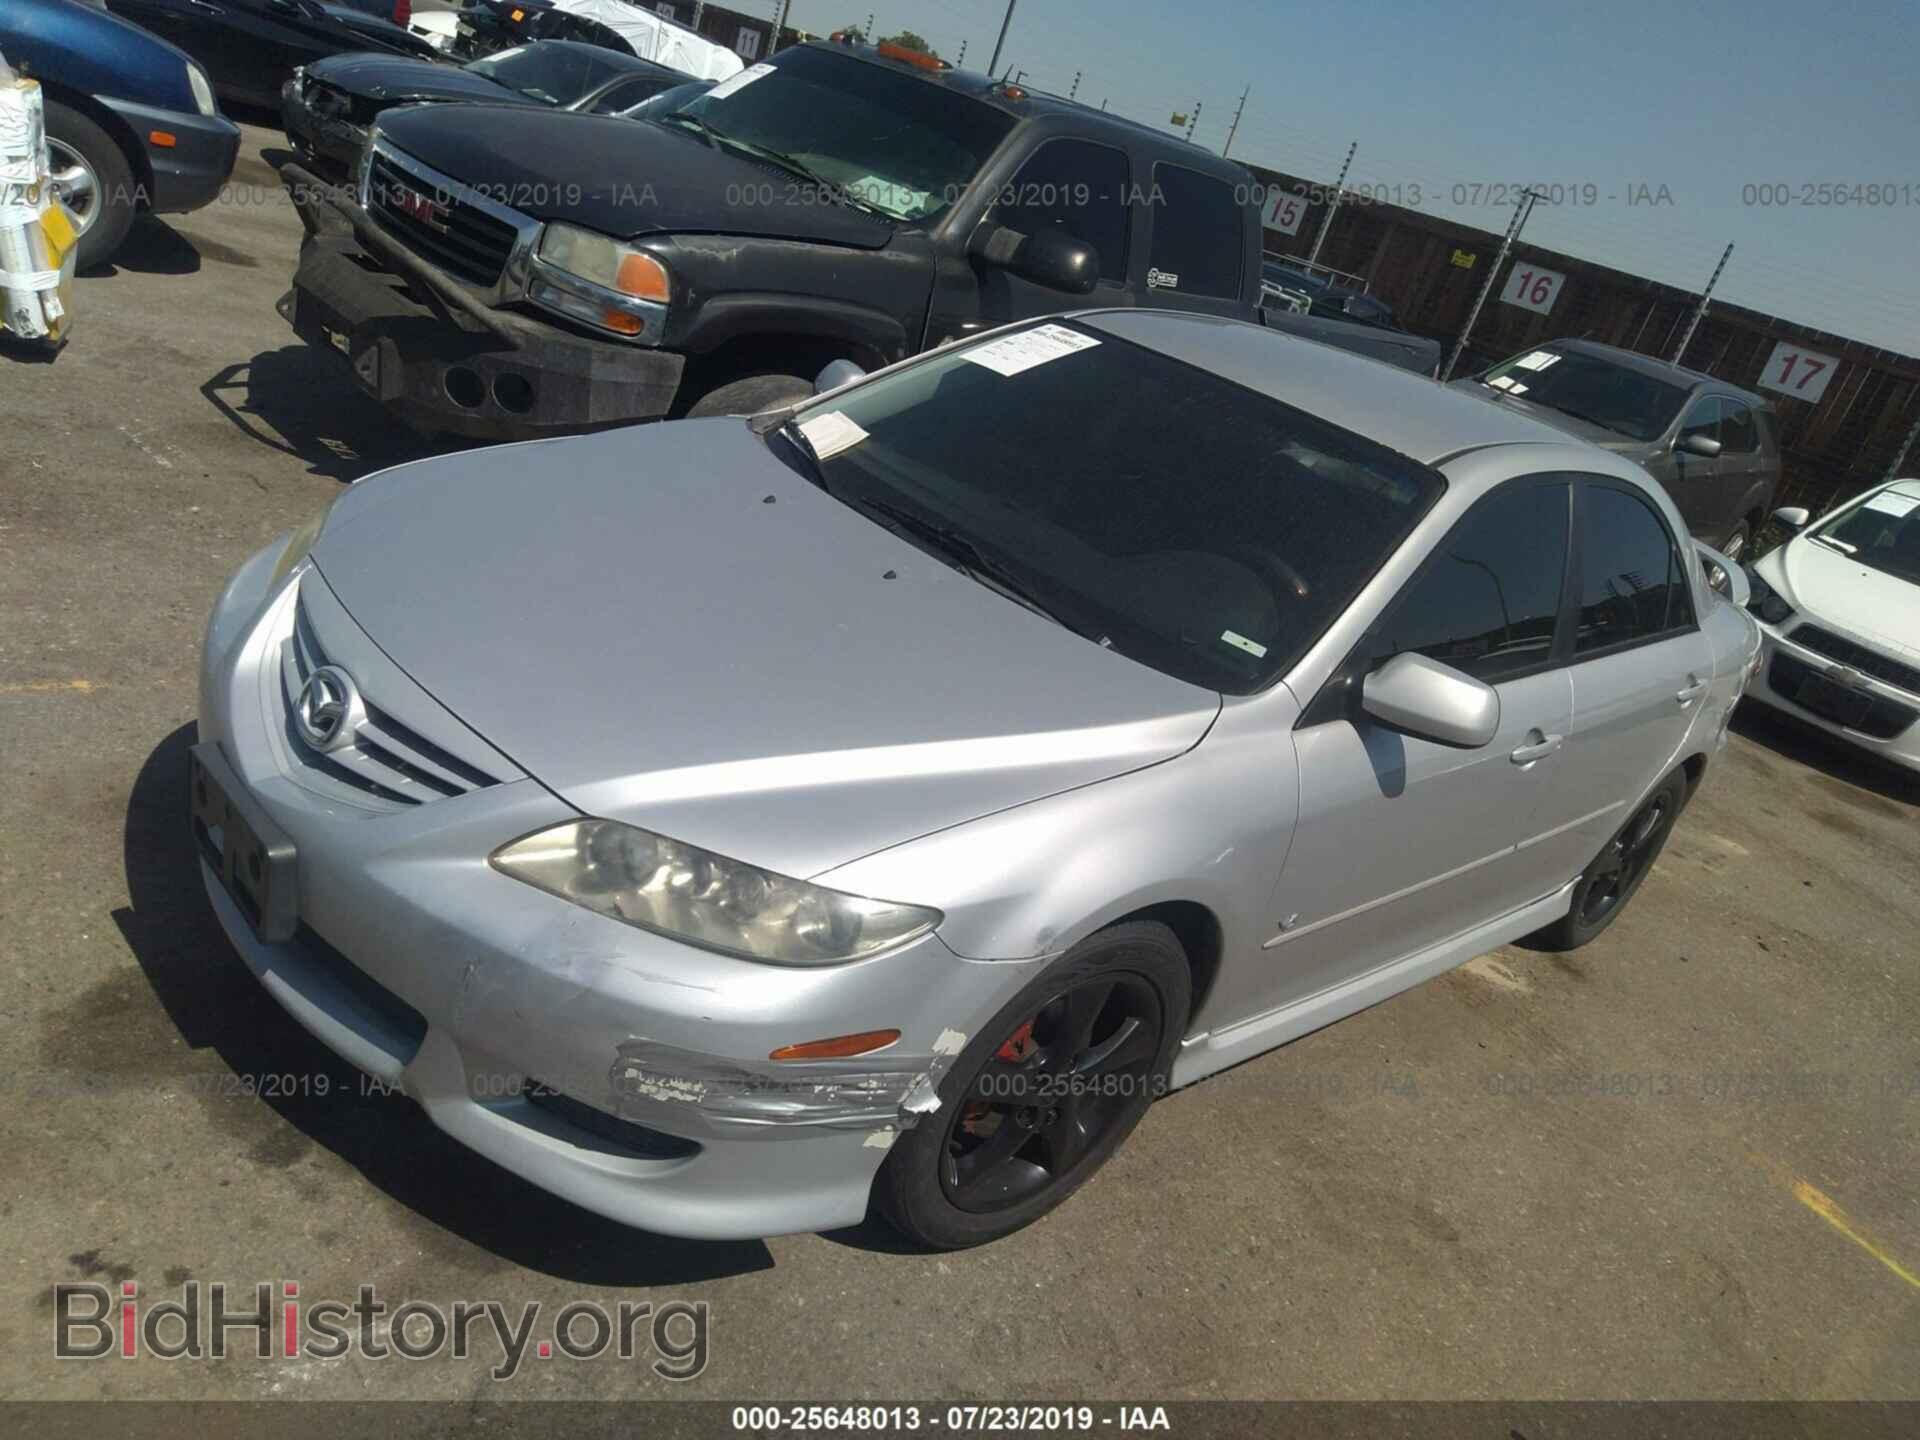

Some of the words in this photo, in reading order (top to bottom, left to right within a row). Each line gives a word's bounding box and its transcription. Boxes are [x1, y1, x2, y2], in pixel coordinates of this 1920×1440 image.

[1270, 197, 1299, 227] 15
[1517, 271, 1552, 305] 16
[1778, 353, 1826, 390] 17
